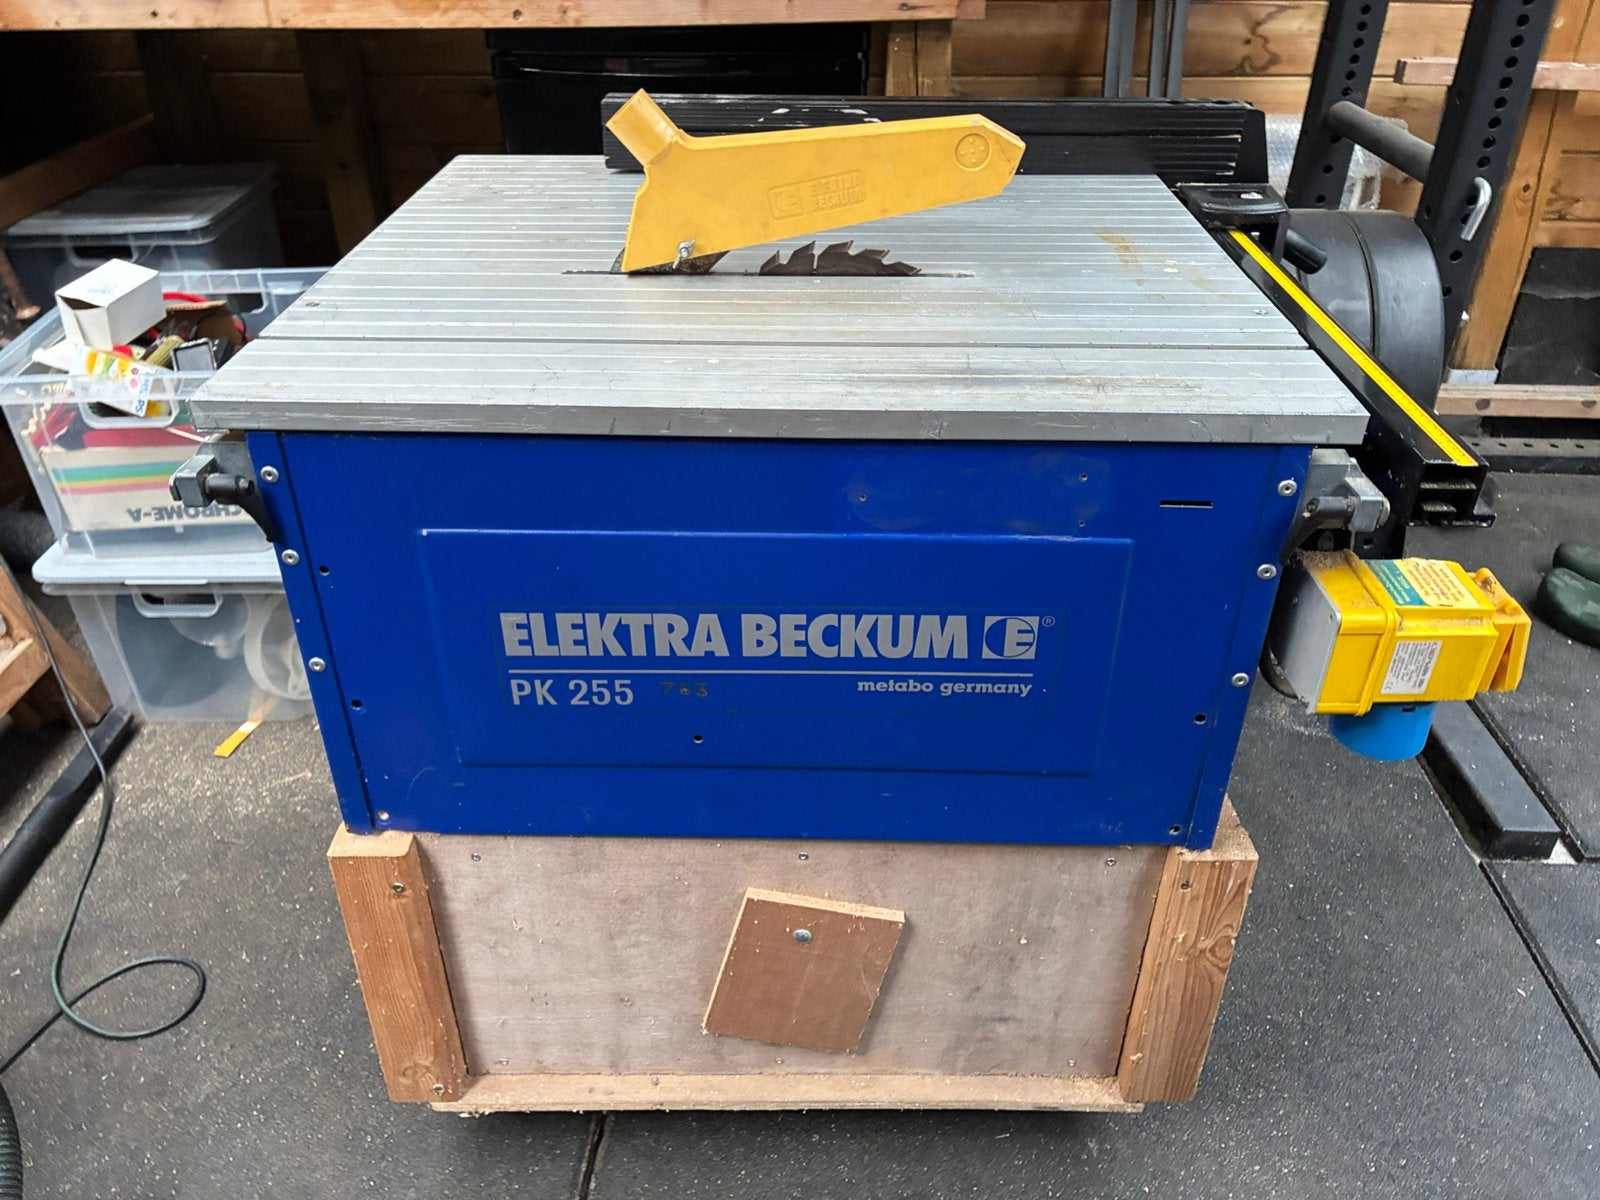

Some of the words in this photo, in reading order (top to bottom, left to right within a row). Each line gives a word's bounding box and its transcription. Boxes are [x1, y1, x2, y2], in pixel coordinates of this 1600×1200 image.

[499, 612, 730, 657] ELEKTRA
[740, 613, 969, 659] BECKUM
[510, 679, 558, 705] PK
[568, 679, 634, 705] 255
[857, 679, 934, 693] metabo
[940, 682, 1033, 697] germany
